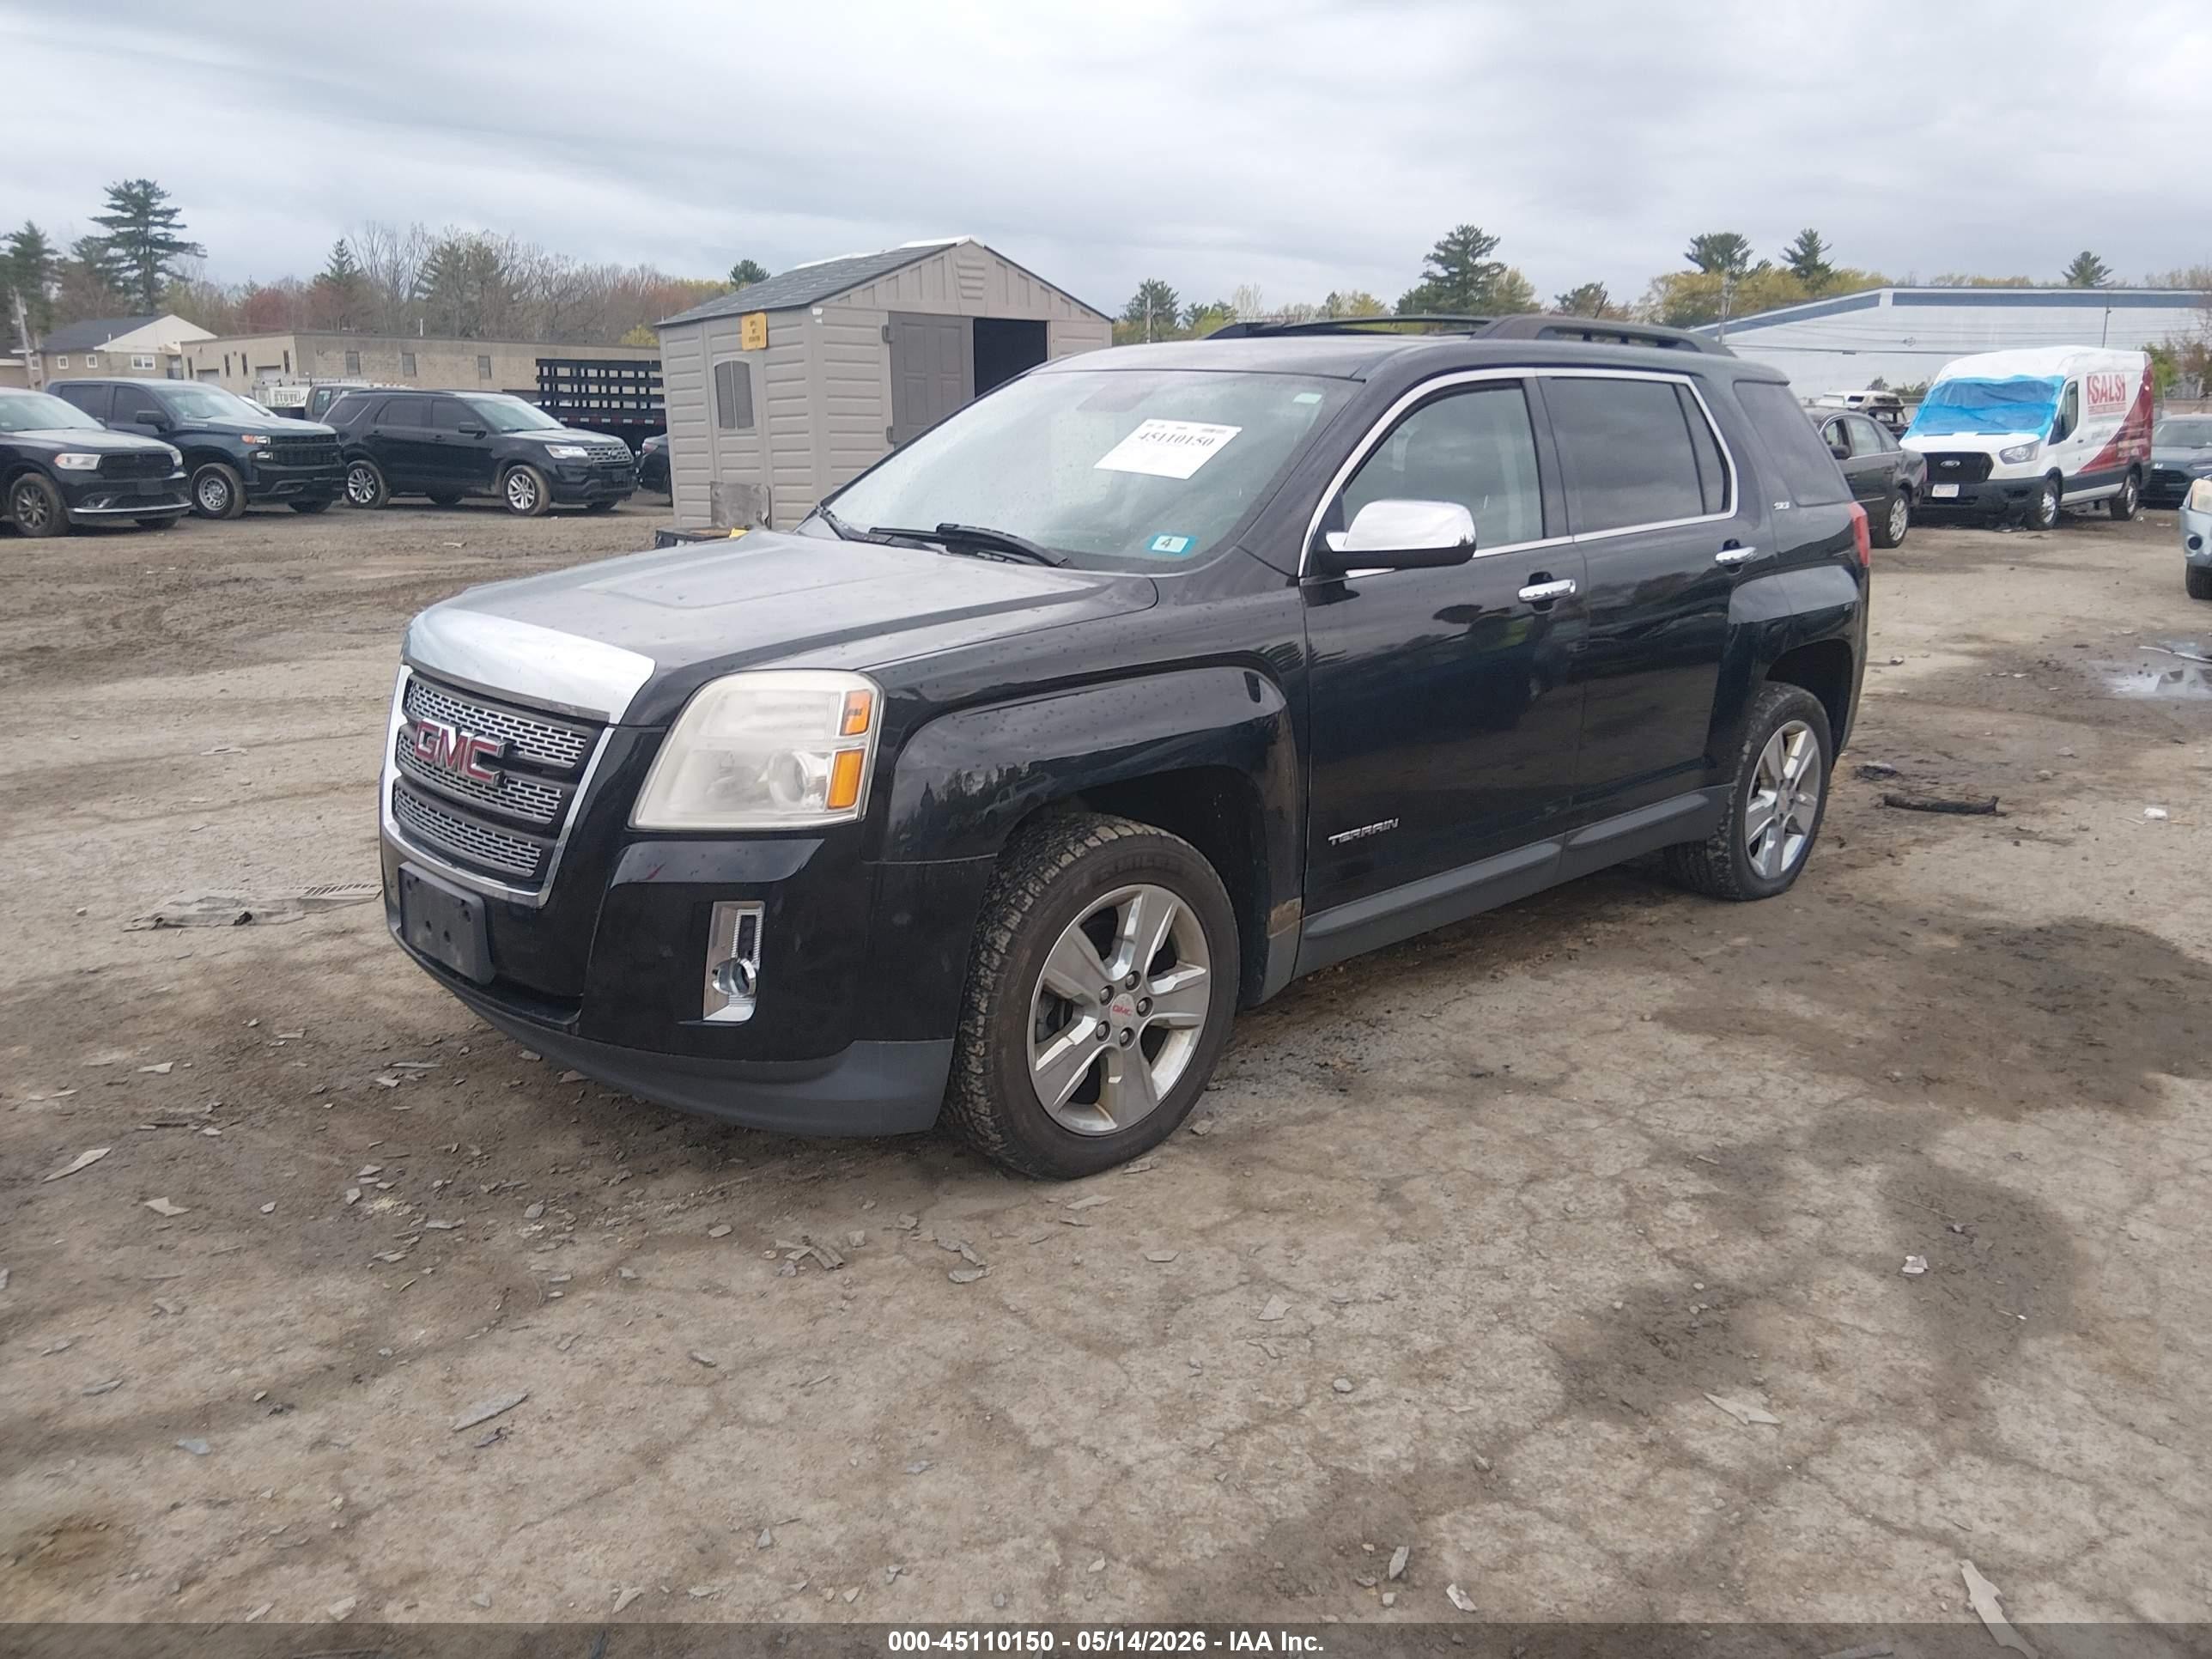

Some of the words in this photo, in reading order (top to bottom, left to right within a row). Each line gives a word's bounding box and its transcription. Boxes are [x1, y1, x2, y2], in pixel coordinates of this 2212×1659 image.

[1138, 431, 1215, 447] 45110150
[1160, 537, 1173, 549] 4
[414, 718, 506, 787] GMC
[1328, 817, 1399, 846] TERRAIN
[1112, 1005, 1132, 1017] GMC
